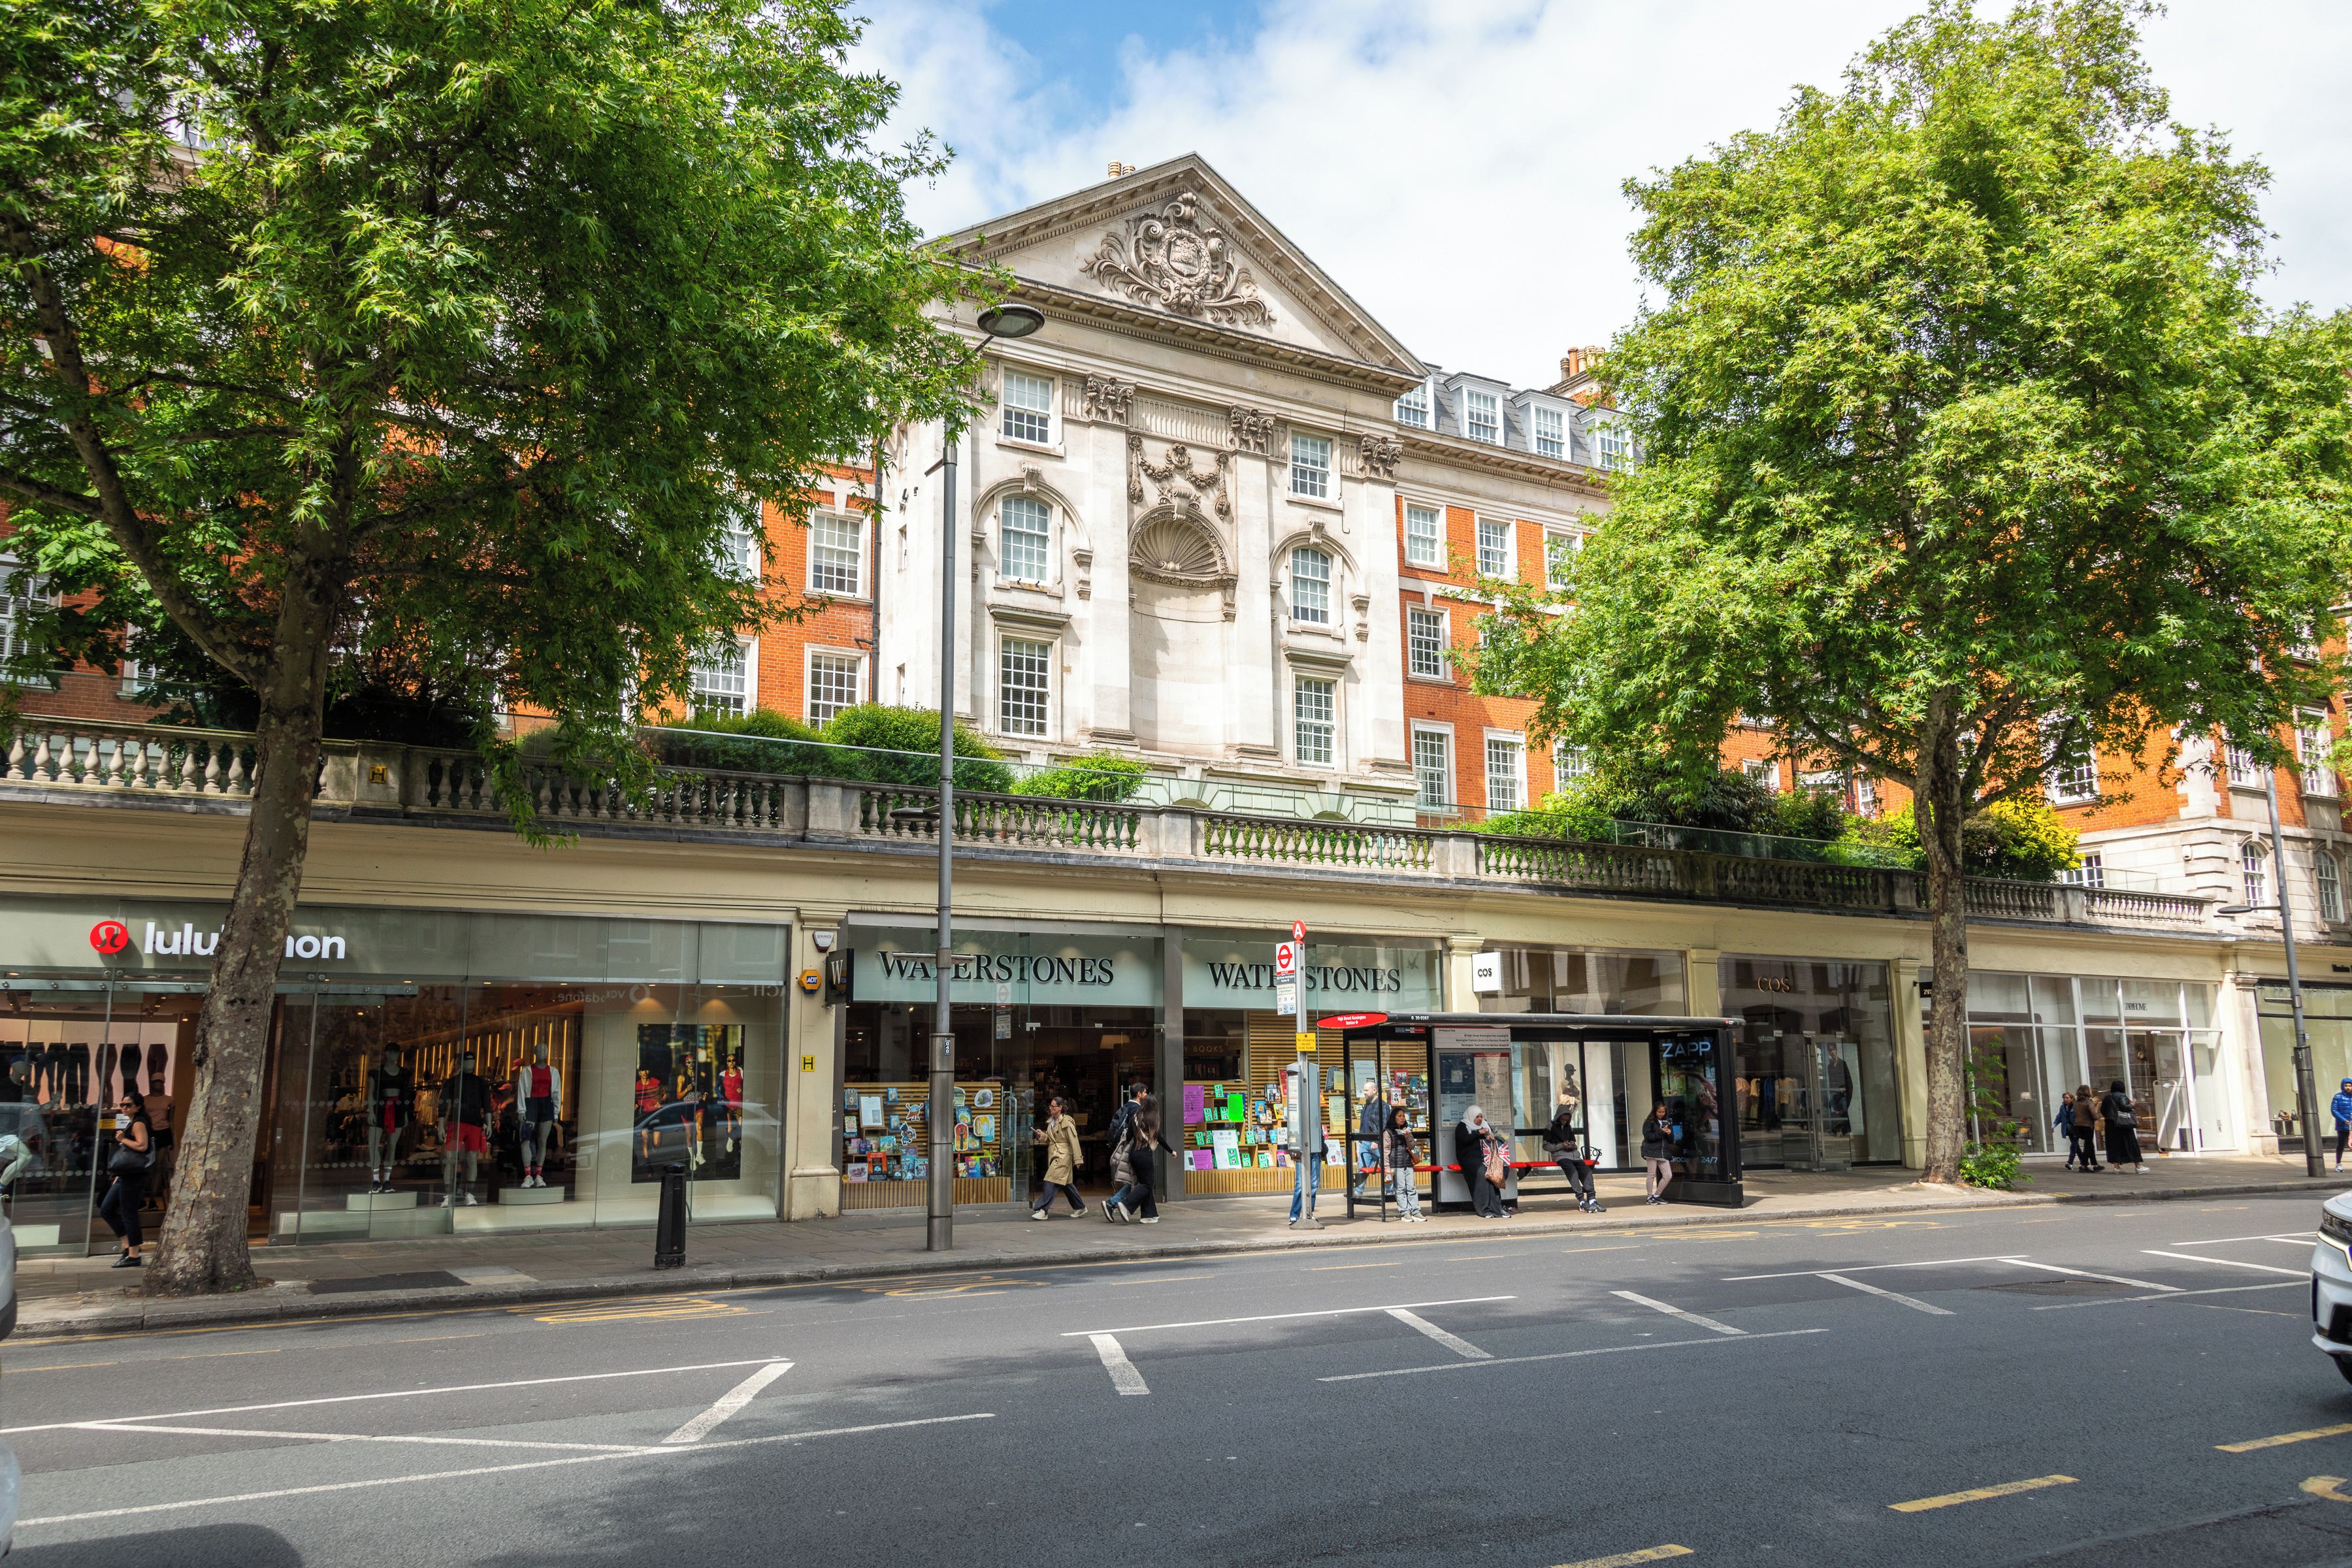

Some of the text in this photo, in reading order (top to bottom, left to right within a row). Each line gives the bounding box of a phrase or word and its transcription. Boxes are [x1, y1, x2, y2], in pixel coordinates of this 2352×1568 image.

[1294, 923, 1303, 938] A
[144, 922, 346, 959] luluon
[831, 959, 843, 985] W
[878, 951, 1114, 984] WAERSTONES
[1478, 968, 1492, 977] COS
[1207, 962, 1401, 992] WATESTONES
[1757, 976, 1791, 993] COS
[1661, 1041, 1711, 1058] ZAPP
[803, 1056, 813, 1070] H
[1701, 1156, 1718, 1164] 24/7
